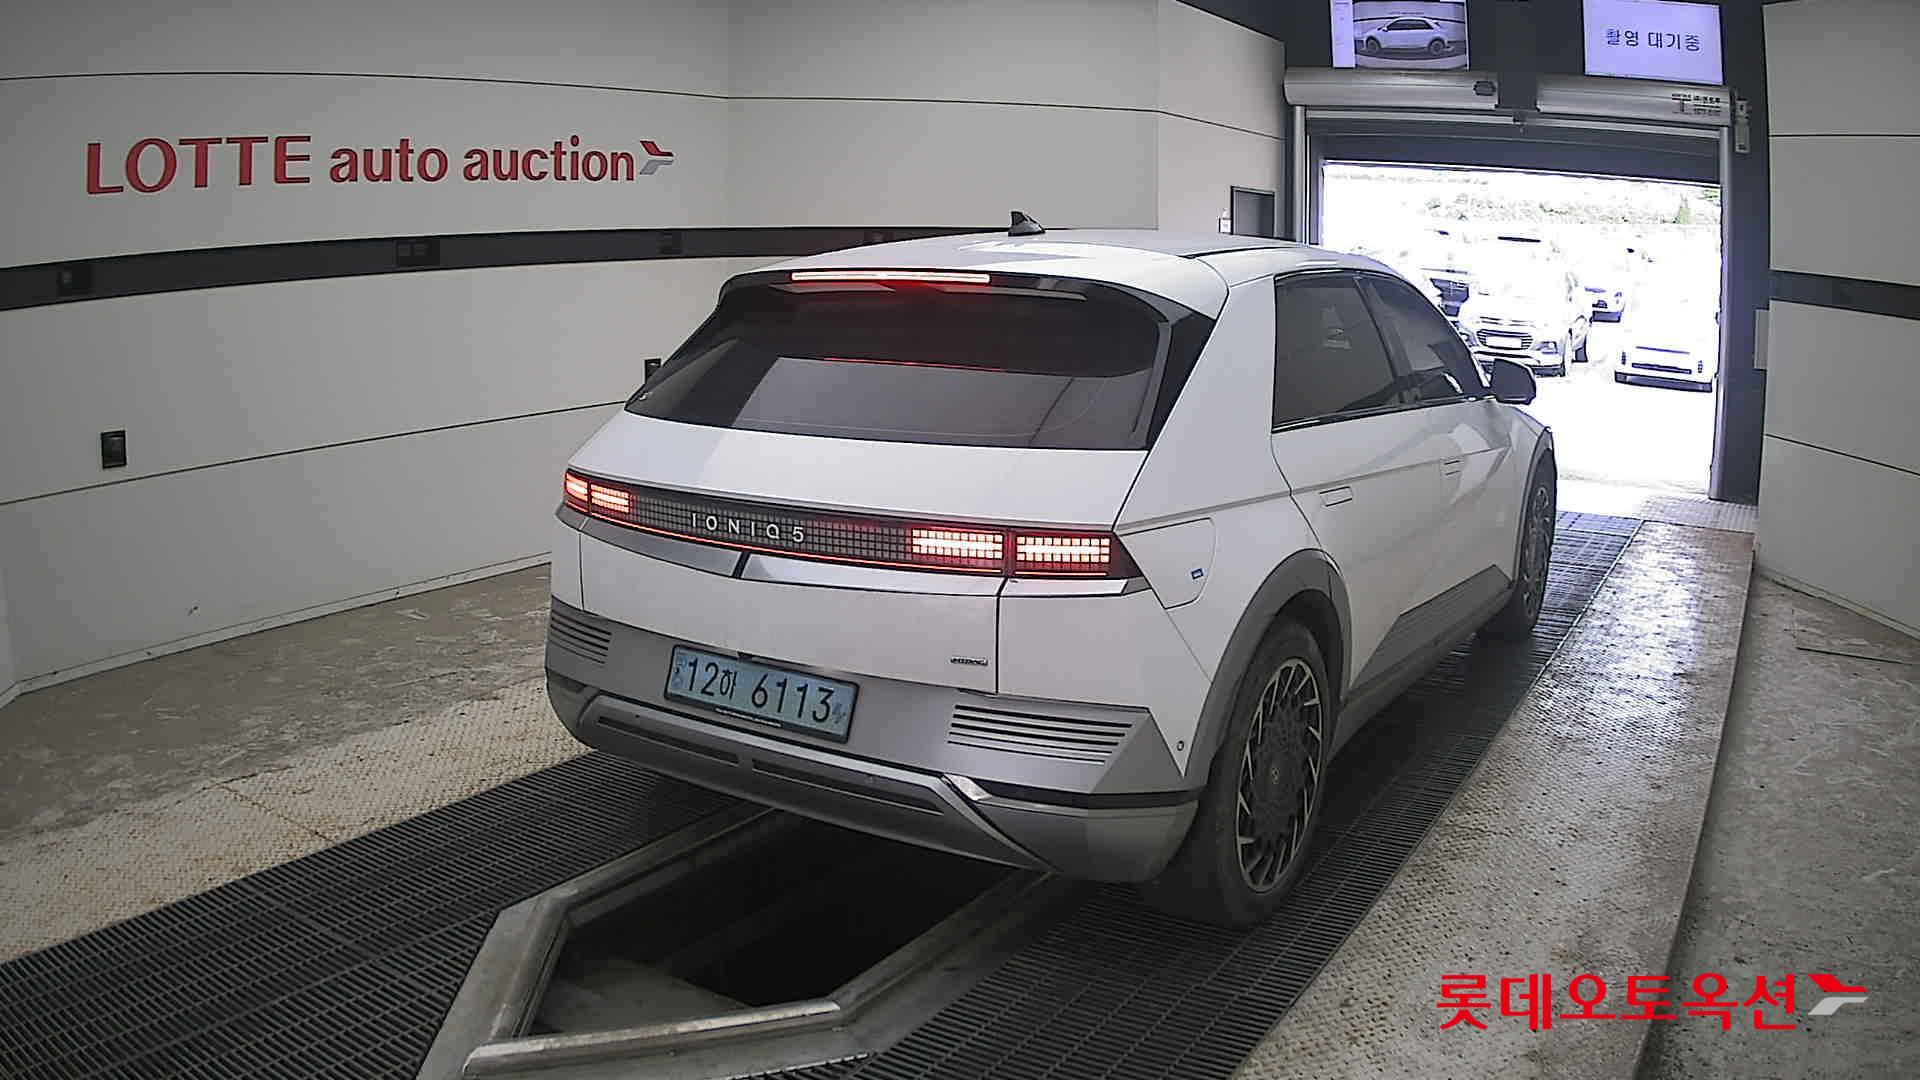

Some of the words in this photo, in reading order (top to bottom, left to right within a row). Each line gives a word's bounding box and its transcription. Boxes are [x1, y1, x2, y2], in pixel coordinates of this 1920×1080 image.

[1647, 31, 1701, 52] 대기중
[86, 135, 312, 195] LOTTE
[329, 137, 449, 183] auto
[462, 134, 635, 183] auction
[690, 512, 781, 540] IONIQ
[791, 525, 805, 543] 5
[751, 673, 835, 724] 6113
